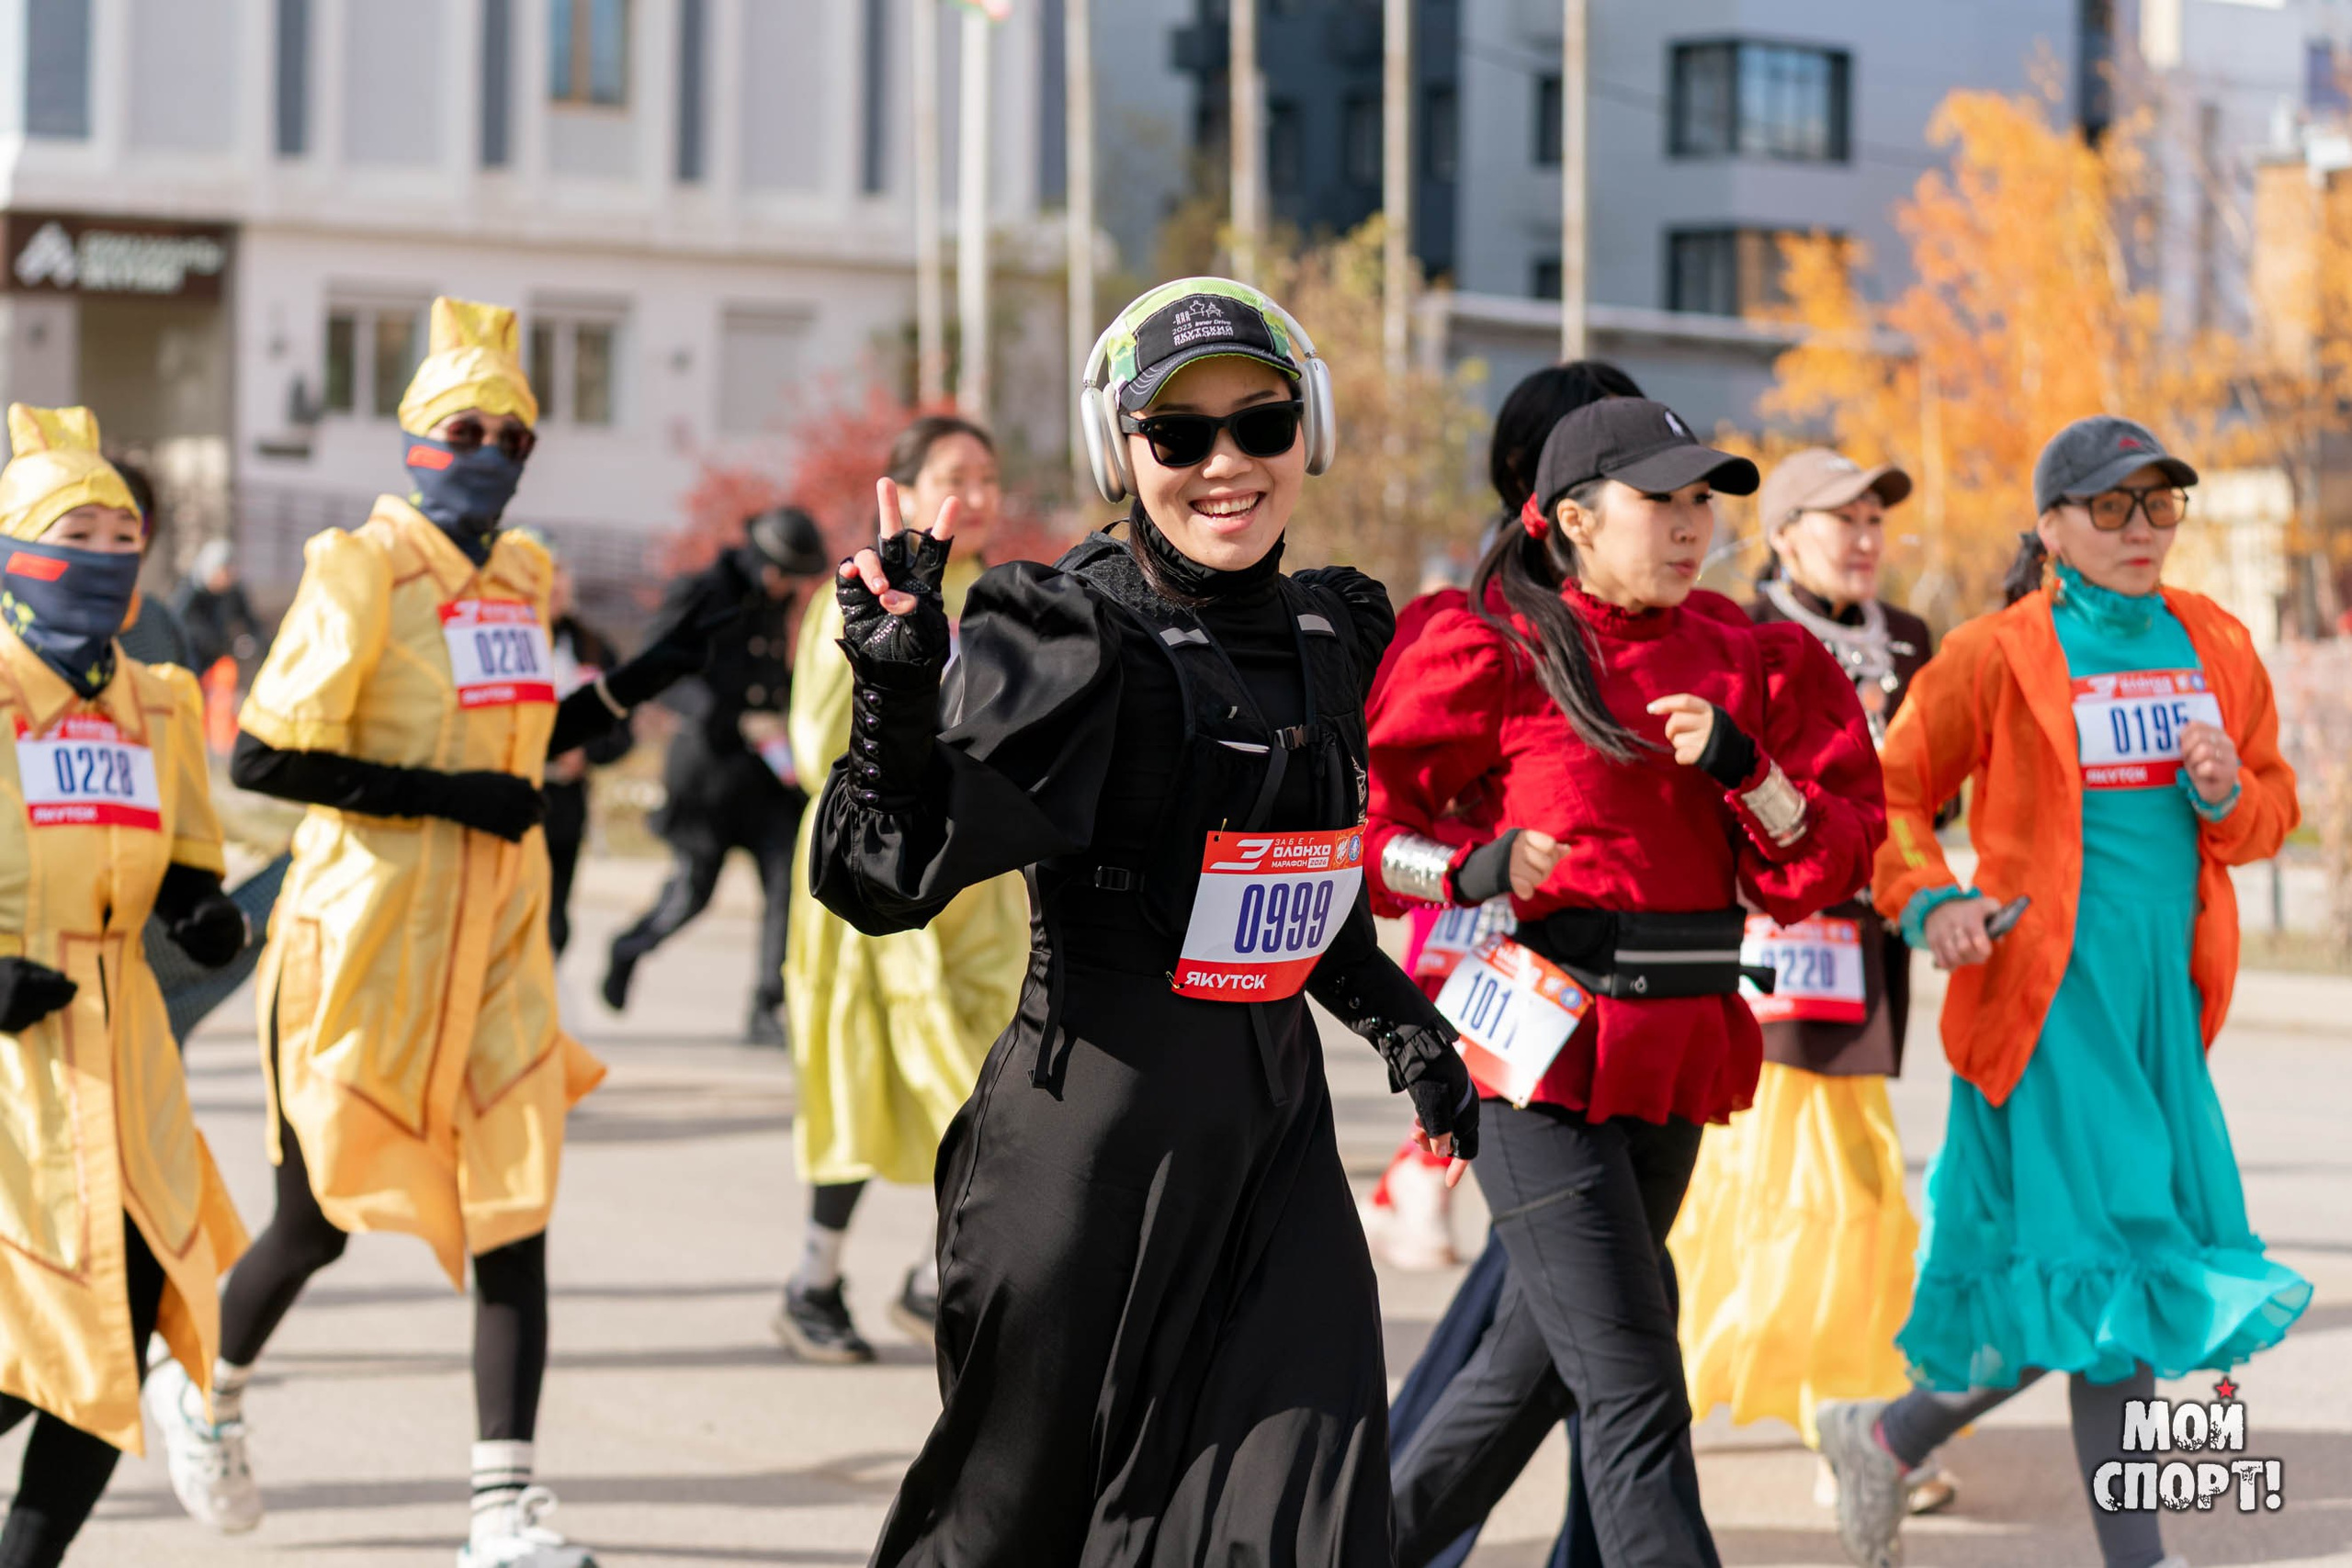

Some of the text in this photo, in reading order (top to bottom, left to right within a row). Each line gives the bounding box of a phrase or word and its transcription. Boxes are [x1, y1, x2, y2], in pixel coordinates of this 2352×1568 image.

[1173, 326, 1233, 341] ЯКУТСКИЙ
[55, 746, 134, 796] 0228
[1272, 844, 1331, 858] ОЛОНХО
[1271, 860, 1307, 868] МАРАФОН
[1234, 879, 1334, 954] 0999
[1184, 971, 1268, 990] ЯКУТСК
